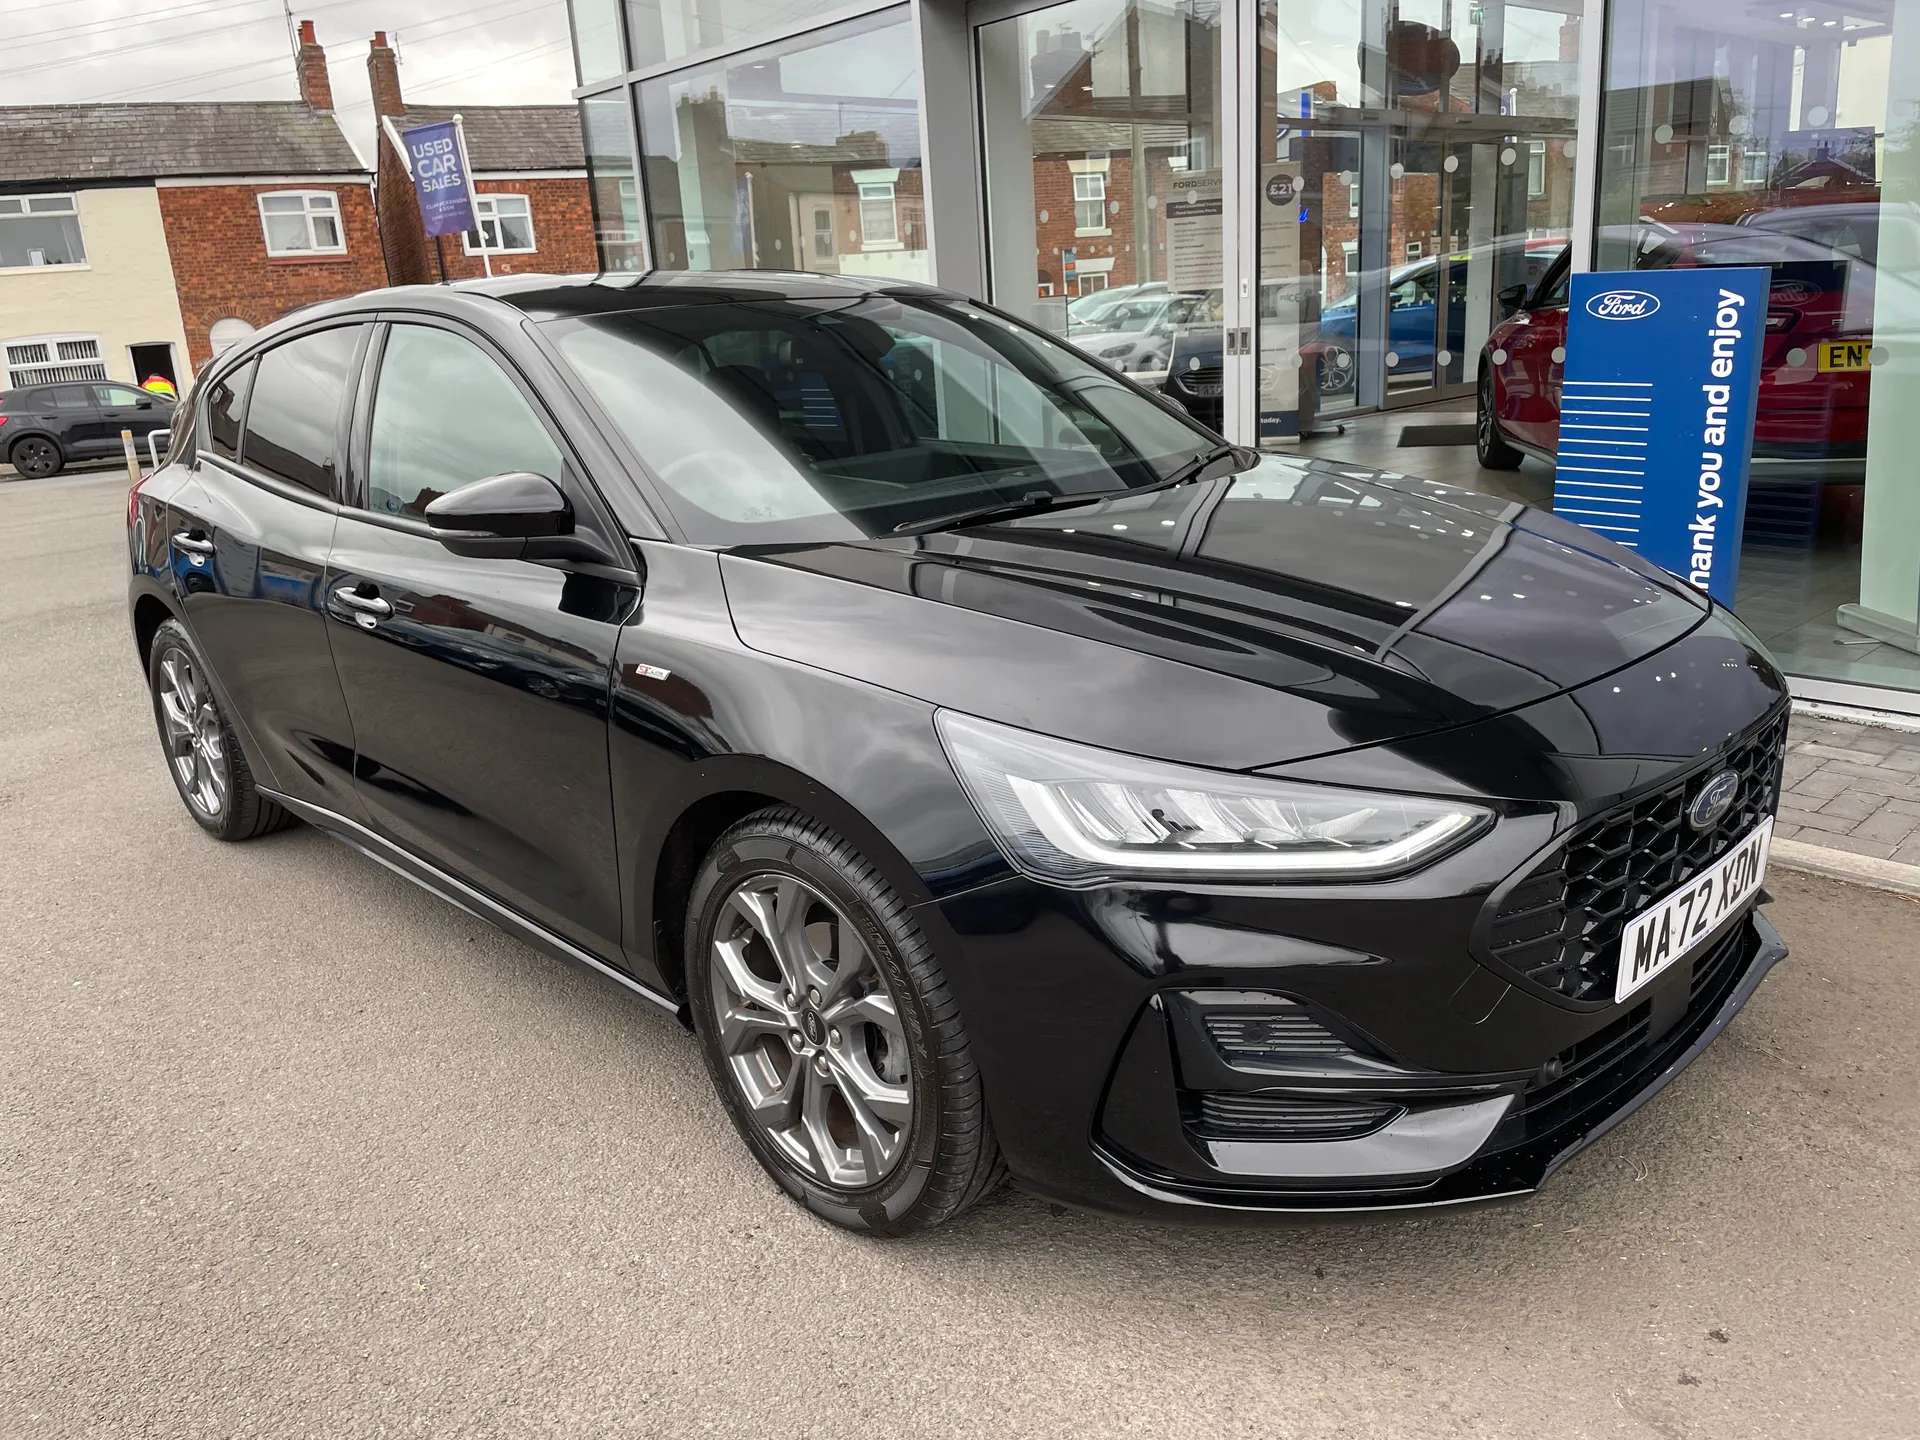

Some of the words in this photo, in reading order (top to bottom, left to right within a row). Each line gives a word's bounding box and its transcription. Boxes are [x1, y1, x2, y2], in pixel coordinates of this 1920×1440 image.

[412, 138, 453, 158] USED
[417, 154, 457, 178] CAR
[422, 174, 461, 193] SALES
[1598, 294, 1647, 315] Ford
[1708, 288, 1745, 378] enjoy
[1702, 384, 1730, 446] and
[1697, 451, 1724, 508] you
[1632, 878, 1713, 982] MA72
[1715, 833, 1763, 918] XDN
